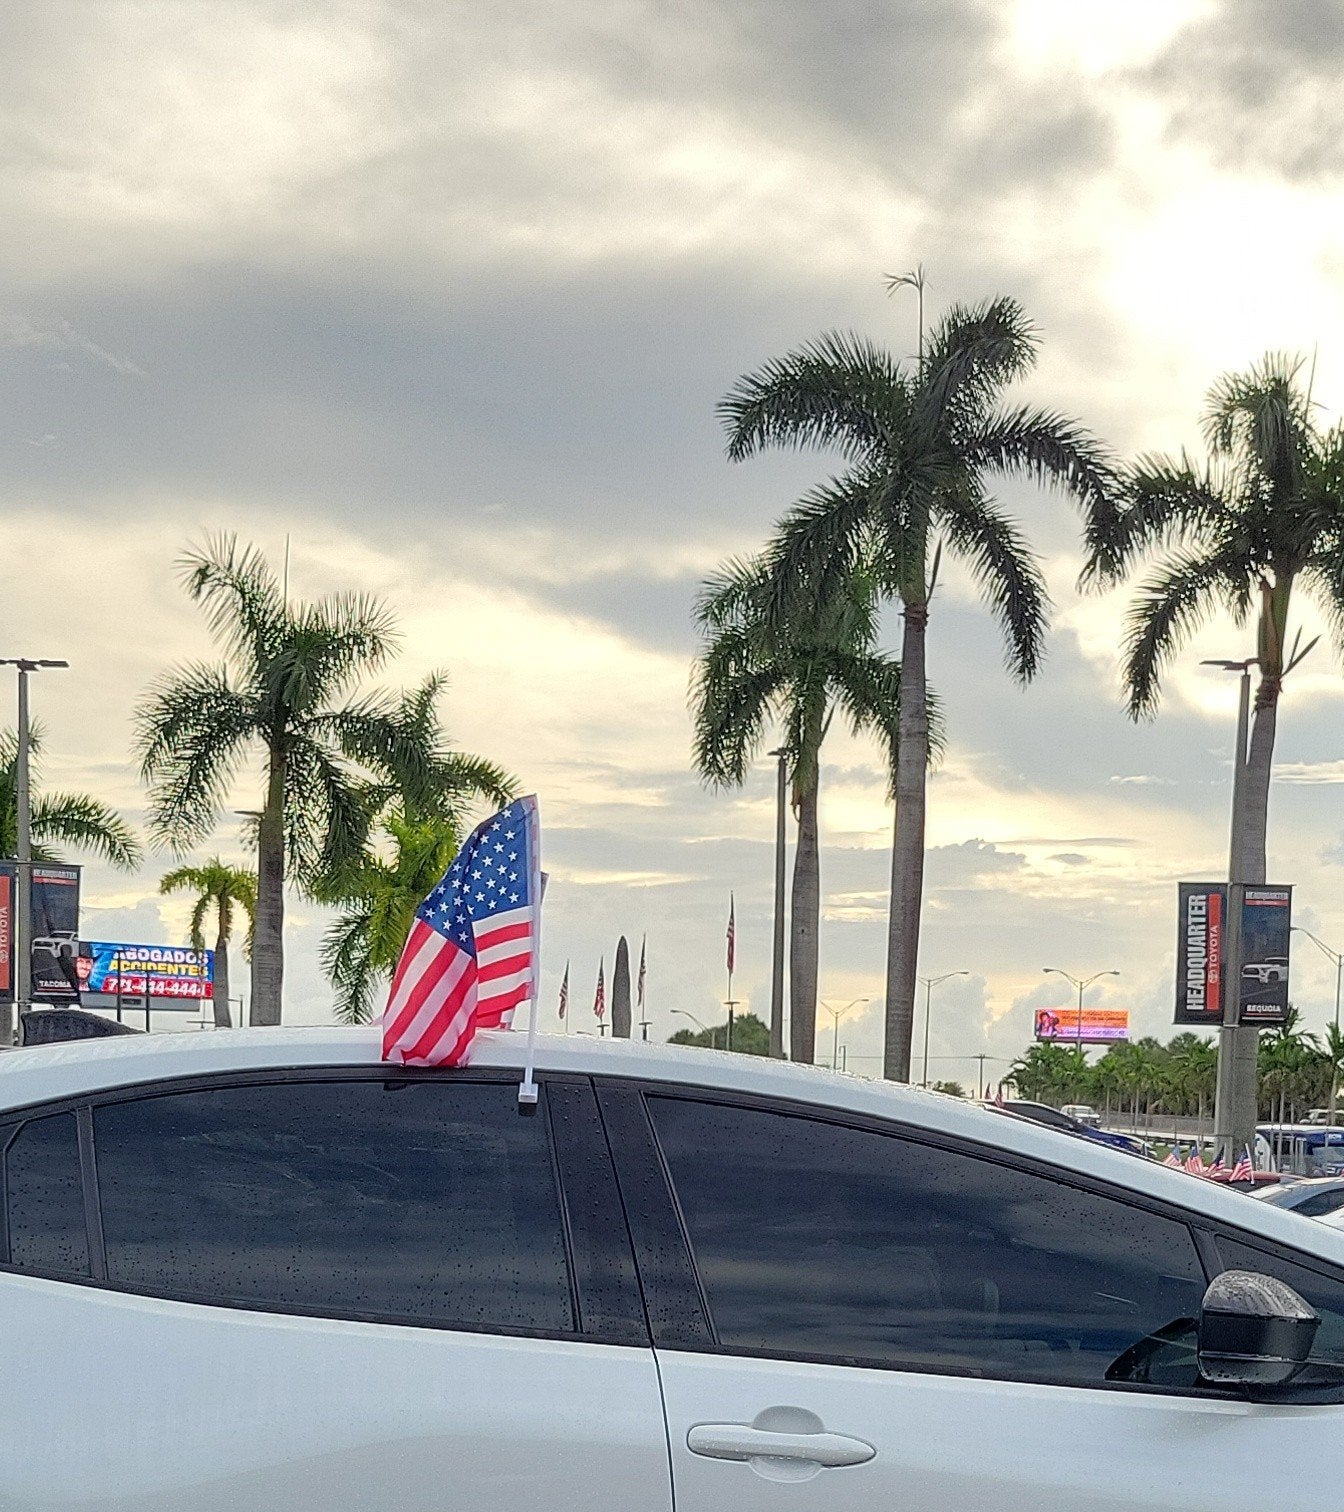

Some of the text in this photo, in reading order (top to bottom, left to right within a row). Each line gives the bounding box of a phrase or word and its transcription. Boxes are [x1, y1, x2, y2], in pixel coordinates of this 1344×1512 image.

[0, 907, 8, 949] TOYOTA
[1209, 925, 1218, 968] TOYOTA
[108, 959, 209, 977] ACCIDENTES
[112, 947, 209, 965] ABOGADOS
[1186, 894, 1208, 1011] HEADQUARTER
